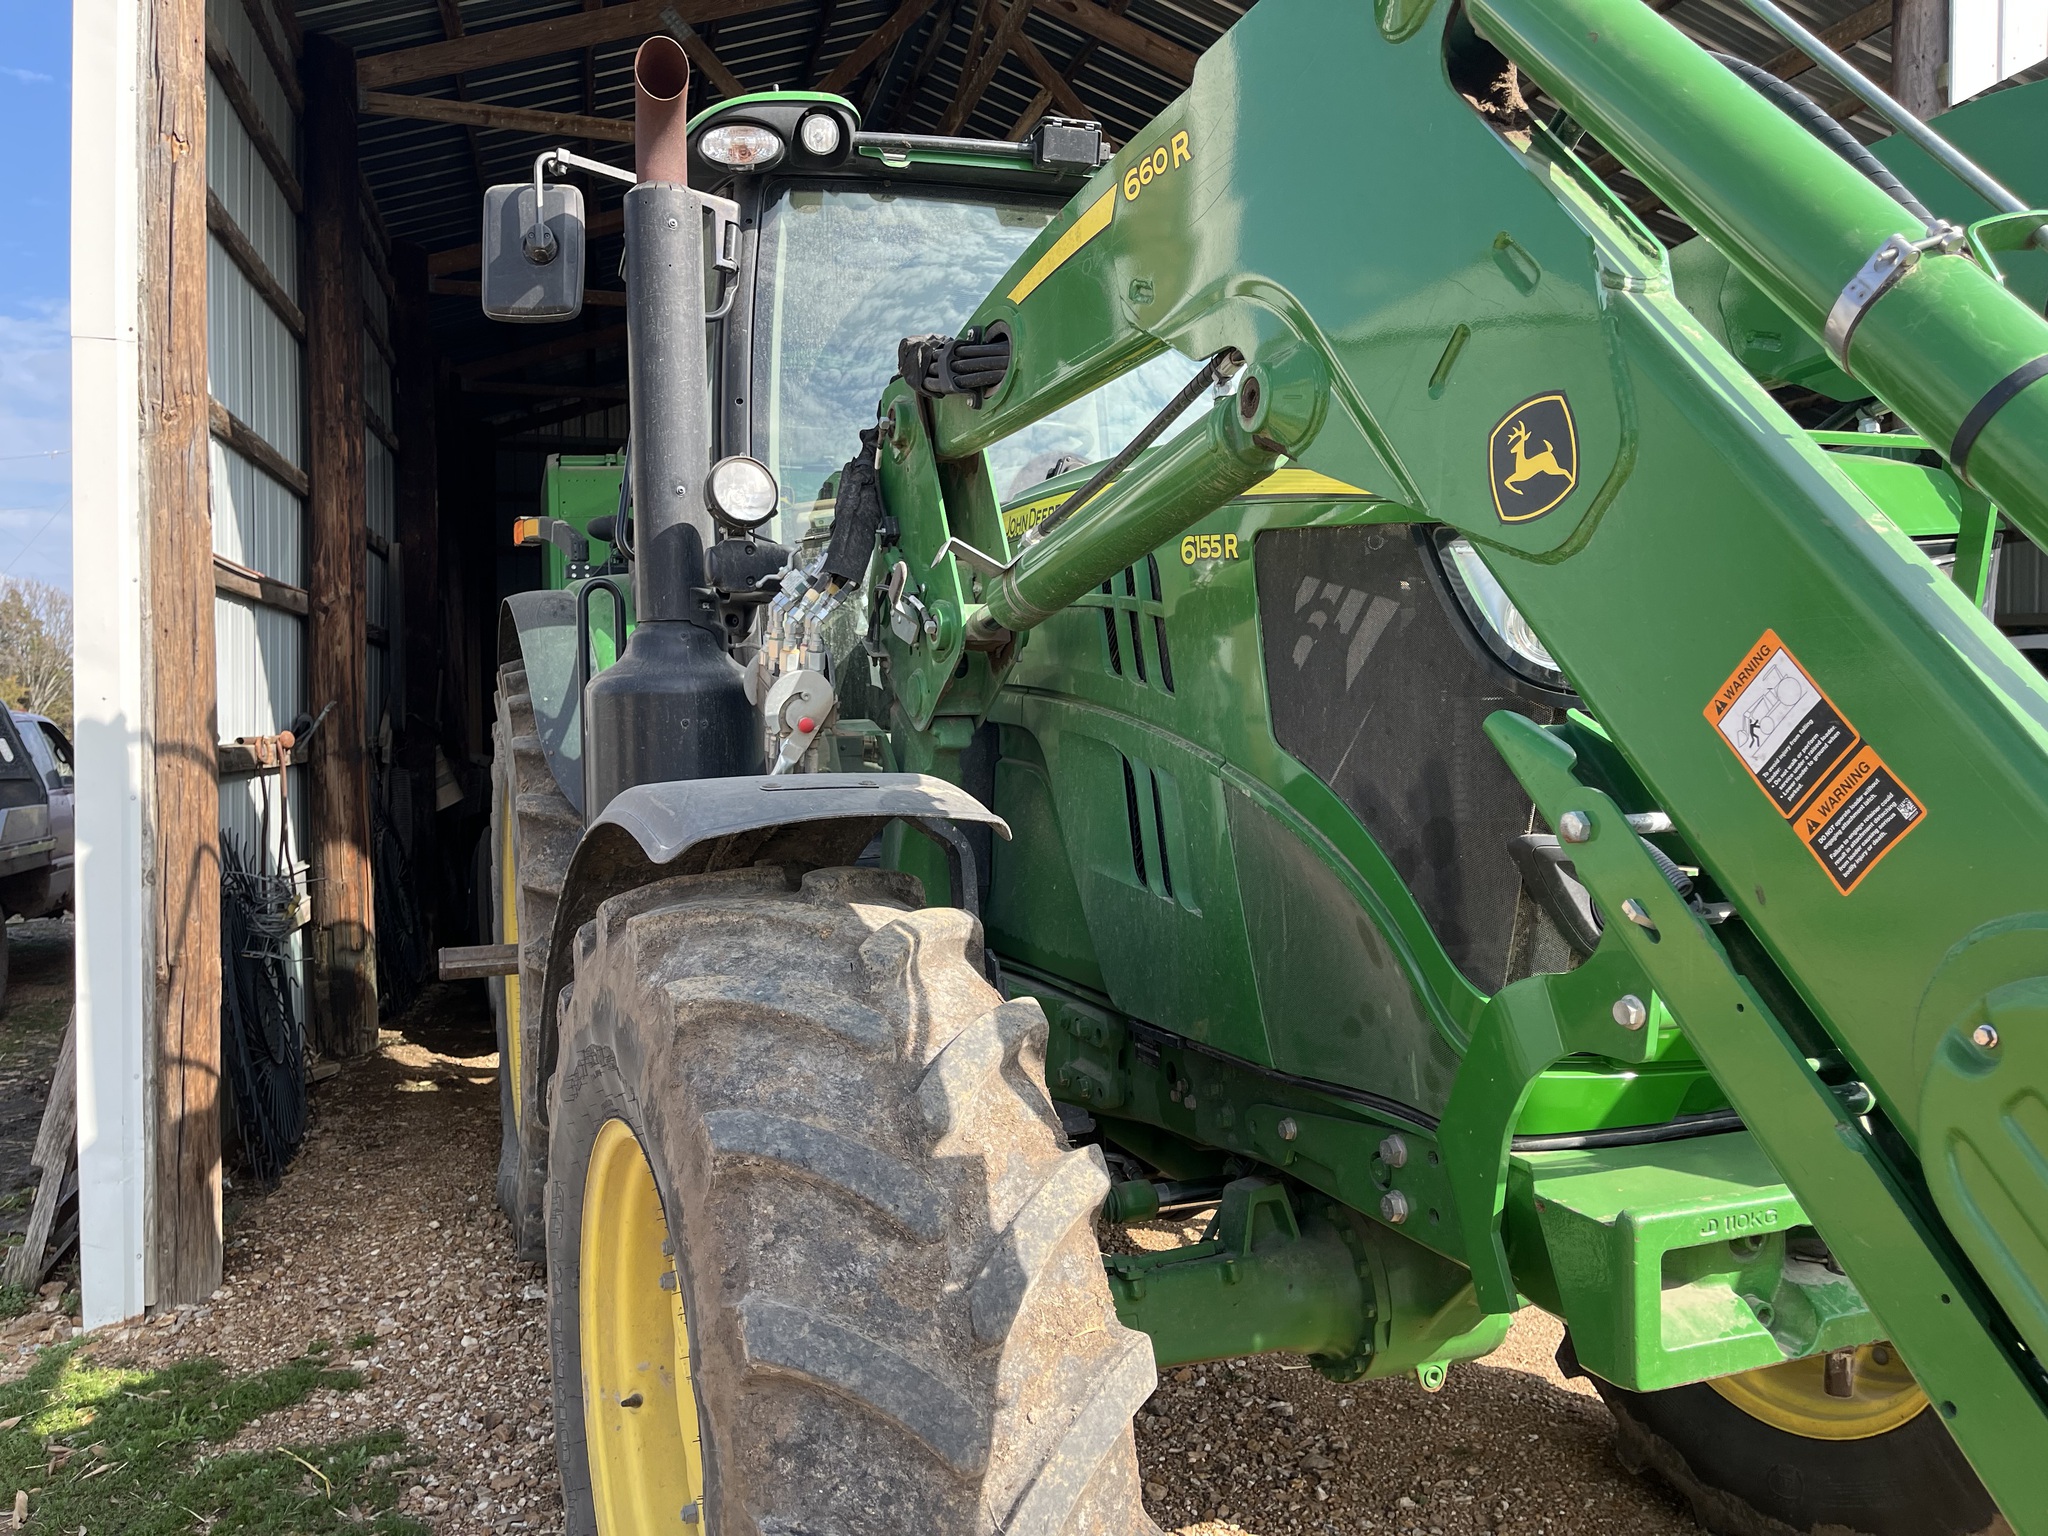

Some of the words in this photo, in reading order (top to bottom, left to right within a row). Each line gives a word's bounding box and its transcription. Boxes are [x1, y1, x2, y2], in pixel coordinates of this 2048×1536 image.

[1123, 146, 1169, 202] 660
[1170, 129, 1193, 170] R
[1006, 513, 1029, 538] JOHN
[1028, 504, 1062, 529] DEE
[1181, 534, 1222, 566] 6155
[1223, 532, 1240, 560] R
[1723, 642, 1771, 702] WARNING
[1762, 769, 1769, 778] To
[1767, 757, 1779, 772] avoid
[1778, 744, 1792, 761] injury
[1789, 732, 1800, 746] from
[1799, 717, 1814, 735] falling
[1766, 766, 1781, 784] loader:
[1773, 775, 1781, 785] Do
[1779, 768, 1788, 778] not
[1786, 757, 1797, 770] walk
[1801, 732, 1819, 754] perform
[1778, 772, 1794, 790] service
[1792, 758, 1805, 774] under
[1807, 739, 1822, 756] raised
[1820, 723, 1836, 742] loader.
[1782, 779, 1796, 796] Lower
[1794, 765, 1809, 782] loader
[1807, 759, 1814, 767] to
[1812, 743, 1829, 762] ground
[1827, 729, 1840, 745] when
[1786, 782, 1803, 801] parked.
[1816, 759, 1870, 818] WARNING
[1817, 834, 1826, 844] DO
[1824, 824, 1836, 837] NOT
[1833, 807, 1852, 828] operate
[1849, 793, 1864, 810] loader
[1862, 777, 1880, 796] without
[1822, 828, 1843, 851] engaging
[1840, 803, 1865, 830] attachment
[1863, 791, 1877, 807] latch.
[1828, 842, 1844, 860] Failure
[1842, 837, 1849, 845] to
[1848, 822, 1865, 841] engage
[1862, 804, 1881, 824] retainer
[1879, 791, 1894, 807] could
[1833, 850, 1847, 866] result
[1849, 821, 1874, 848] attachment
[1872, 799, 1897, 825] detaching
[1838, 859, 1849, 872] from
[1847, 845, 1862, 861] loader
[1861, 827, 1879, 848] causing
[1877, 810, 1896, 830] serious
[1842, 861, 1857, 878] bodily
[1854, 849, 1868, 865] injury
[1871, 829, 1887, 846] death.
[1724, 1208, 1778, 1233] 110KG
